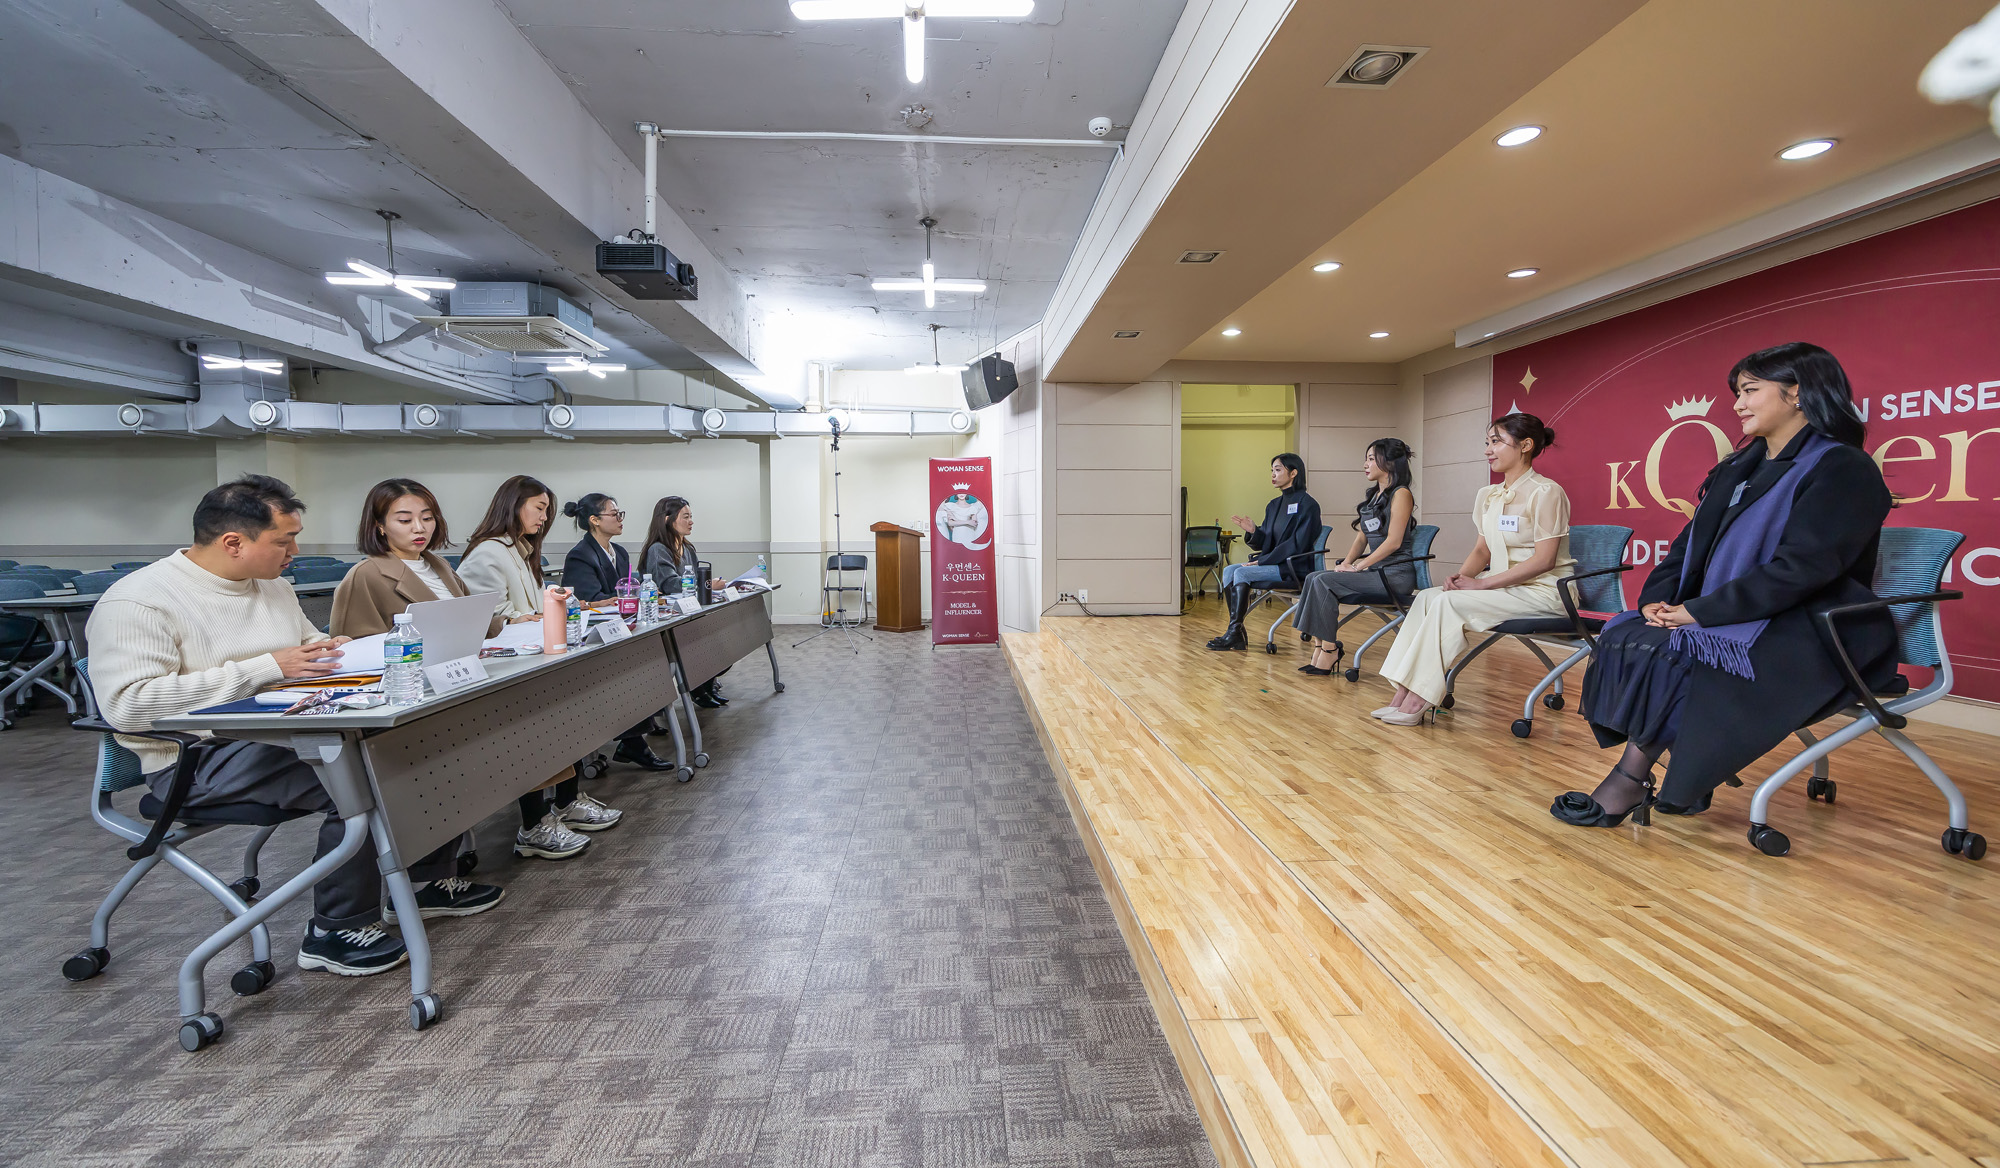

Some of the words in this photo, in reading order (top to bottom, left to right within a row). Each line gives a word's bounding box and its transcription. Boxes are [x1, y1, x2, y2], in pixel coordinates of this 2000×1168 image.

[1880, 379, 2000, 421] SENSE
[946, 562, 981, 572] 우먼센스
[942, 573, 985, 583] K-QUEEN
